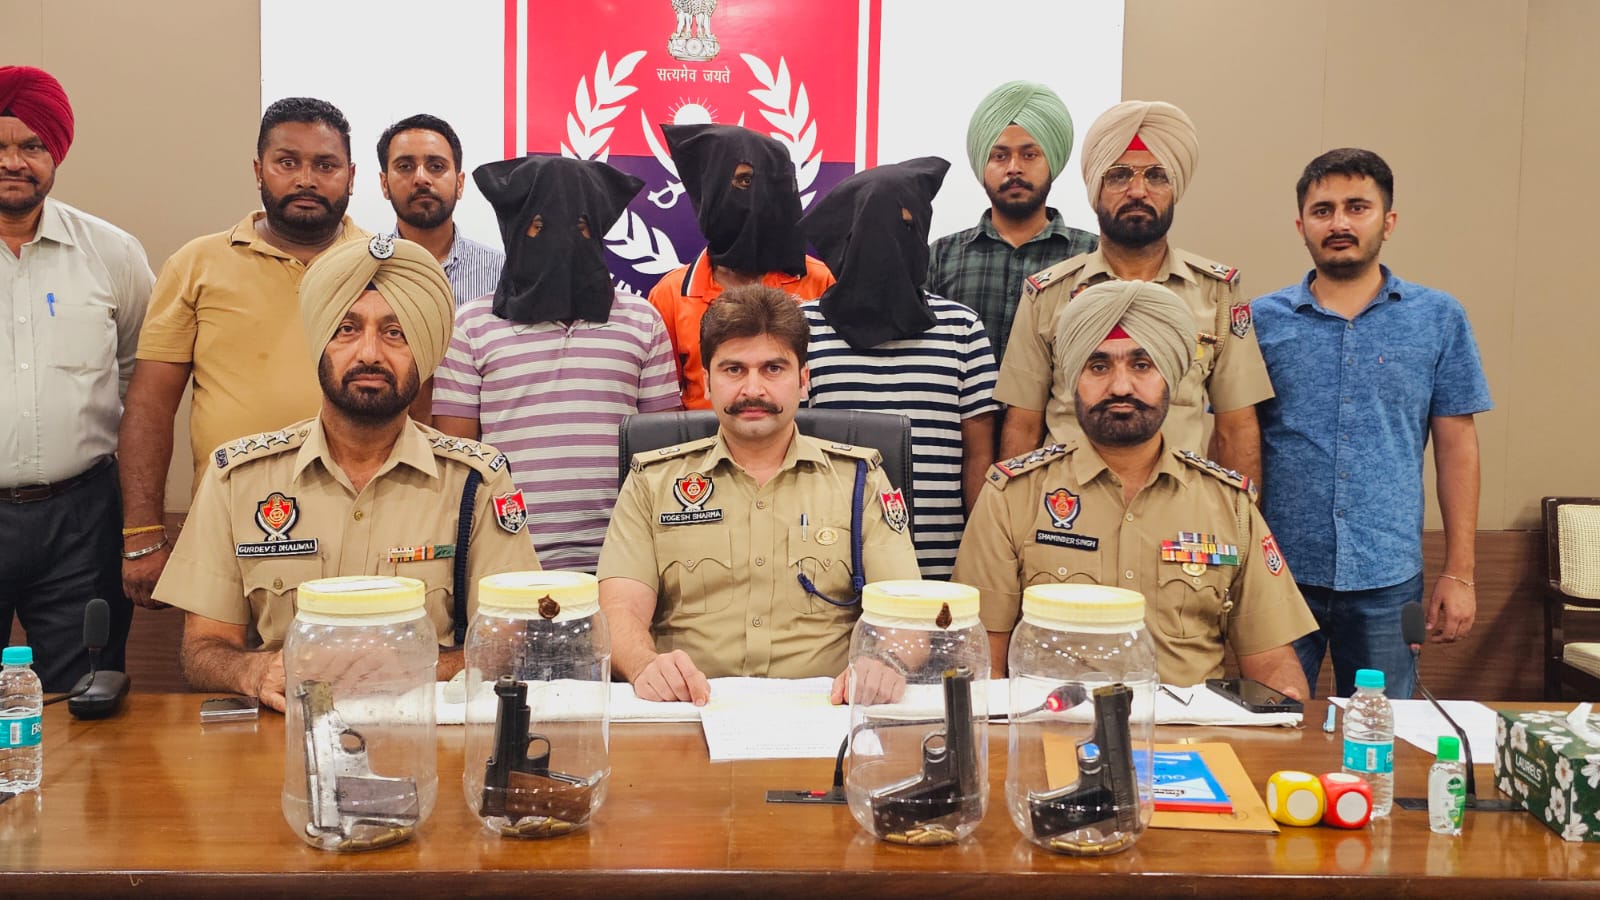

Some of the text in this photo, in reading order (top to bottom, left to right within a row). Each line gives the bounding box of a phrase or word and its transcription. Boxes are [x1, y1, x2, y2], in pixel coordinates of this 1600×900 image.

[656, 64, 731, 83] सत्यमेव जयते
[662, 511, 721, 522] YOGESH SHARMA
[1037, 532, 1075, 545] SHAMINDER
[278, 542, 315, 552] DHALIWAL
[1515, 753, 1542, 781] LAURELS
